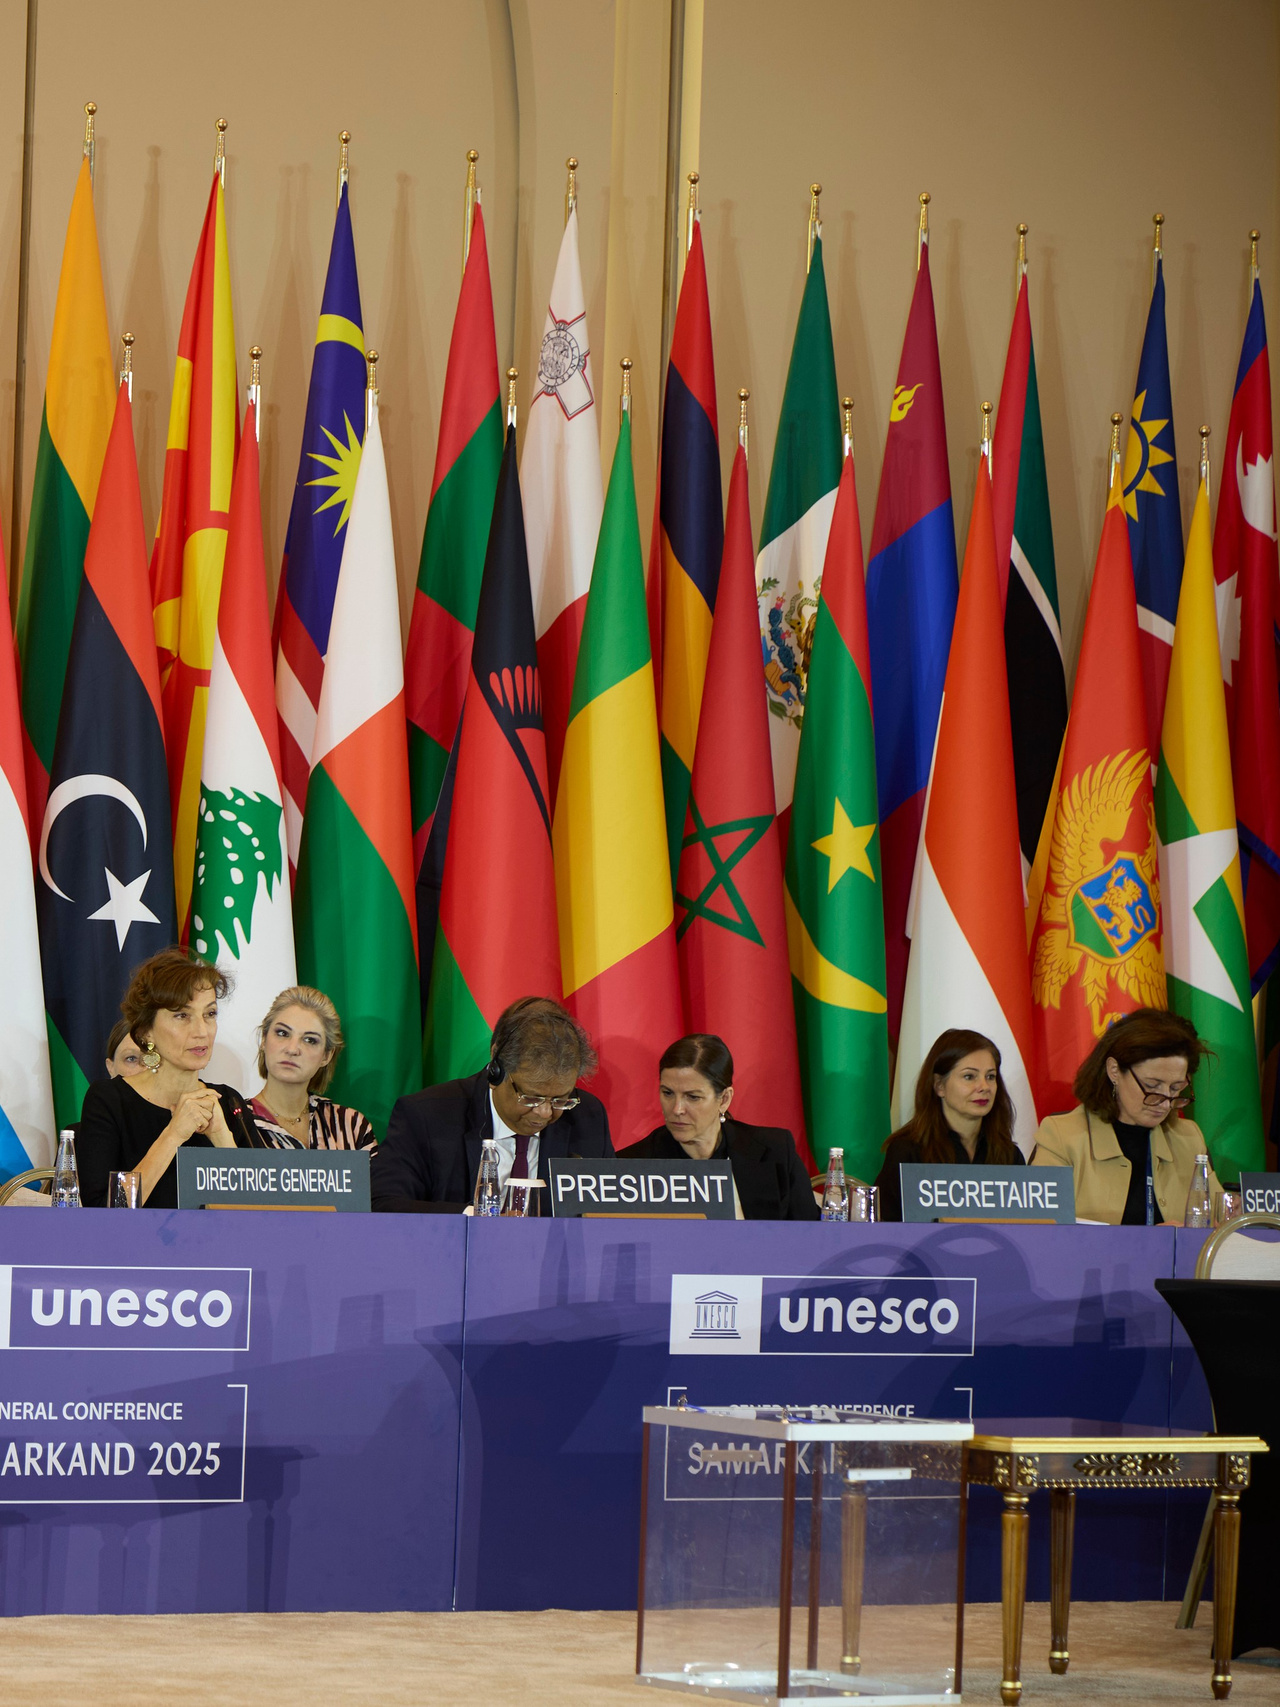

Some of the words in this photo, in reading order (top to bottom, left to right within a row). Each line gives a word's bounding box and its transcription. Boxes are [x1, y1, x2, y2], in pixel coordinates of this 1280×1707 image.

[196, 1166, 277, 1192] DIRECTRICE
[280, 1168, 352, 1193] GENERALE
[556, 1174, 728, 1203] PRESIDENT
[918, 1179, 1059, 1209] SECRETAIRE
[31, 1288, 233, 1328] unesco
[696, 1304, 736, 1329] UNESCO
[779, 1297, 960, 1335] unesco
[62, 1401, 183, 1421] CONFERENCE
[147, 1441, 221, 1476] 2025
